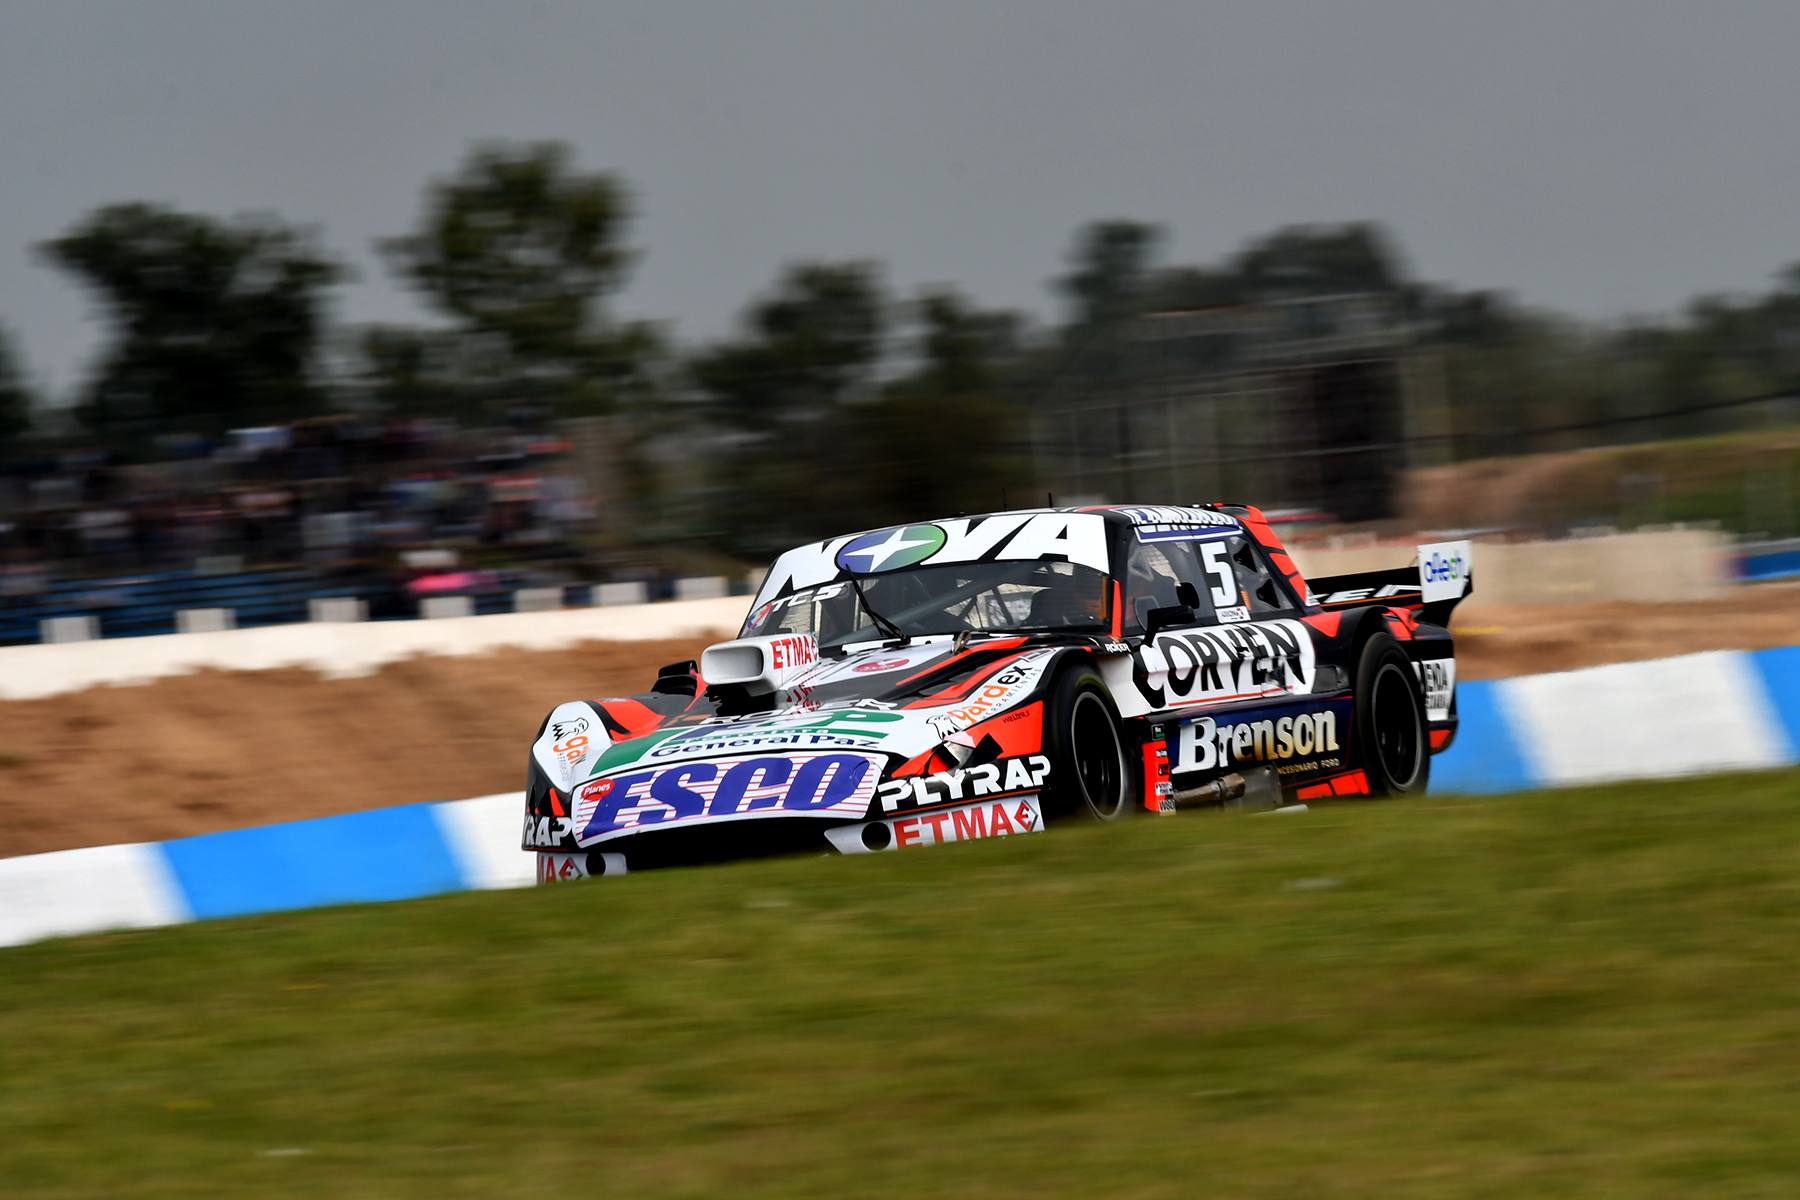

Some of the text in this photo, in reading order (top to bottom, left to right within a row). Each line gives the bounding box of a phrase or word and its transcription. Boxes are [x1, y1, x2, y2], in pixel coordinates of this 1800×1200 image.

[1200, 541, 1238, 608] 5
[770, 634, 812, 670] ETMA
[1133, 622, 1306, 709] CORVEN
[650, 733, 881, 758] General Paz
[1171, 710, 1340, 774] Brenson
[581, 754, 871, 841] ESCO
[583, 782, 612, 796] Planes
[877, 755, 1051, 812] PLYRAP
[893, 803, 1016, 849] ETMA
